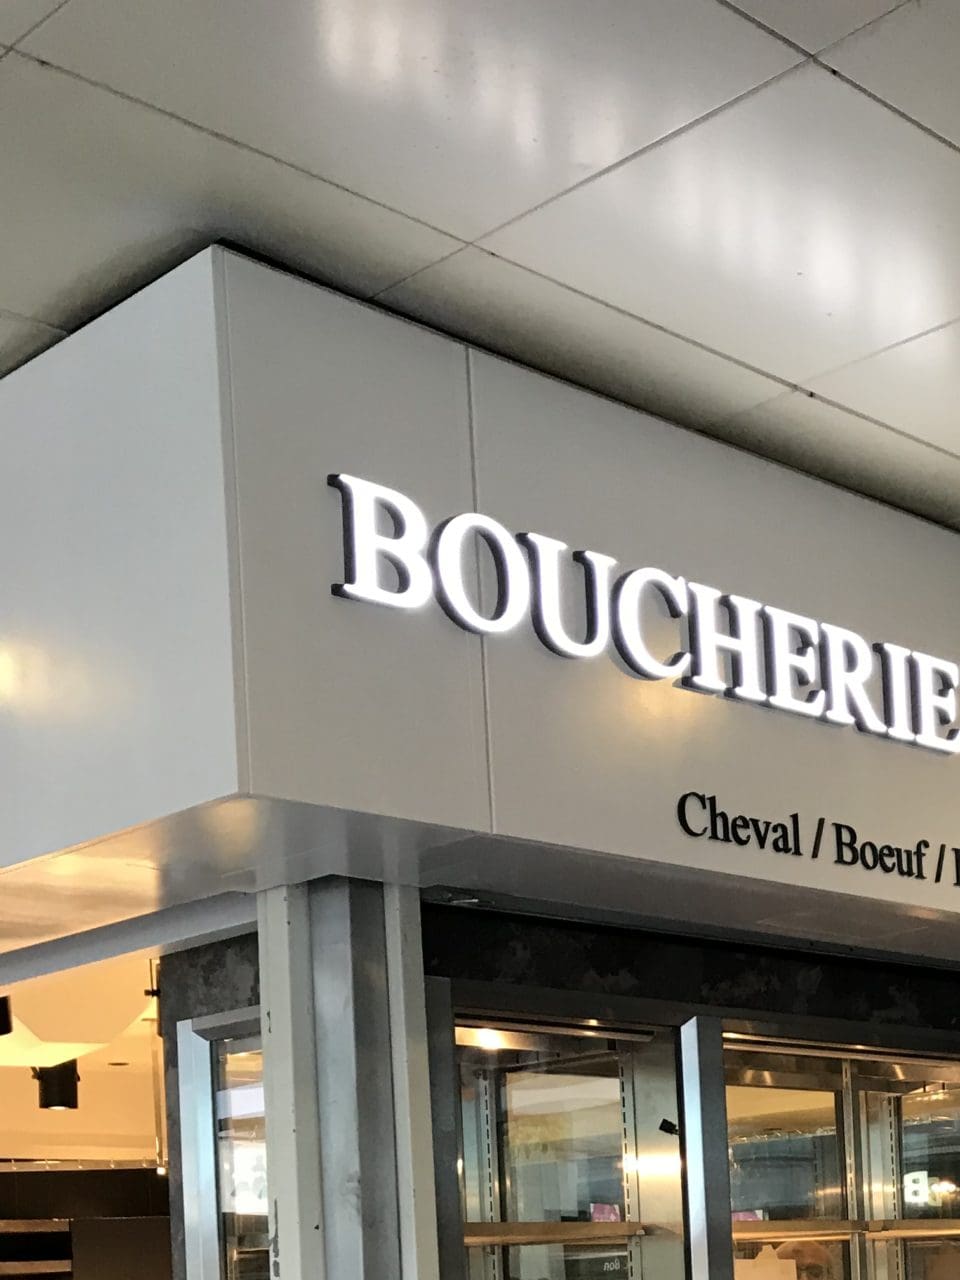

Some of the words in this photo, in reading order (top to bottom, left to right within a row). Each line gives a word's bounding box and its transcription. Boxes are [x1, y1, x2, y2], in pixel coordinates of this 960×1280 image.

[677, 792, 802, 856] Cheval
[812, 818, 825, 858] /
[831, 822, 930, 880] Boeuf
[934, 843, 946, 883] /
